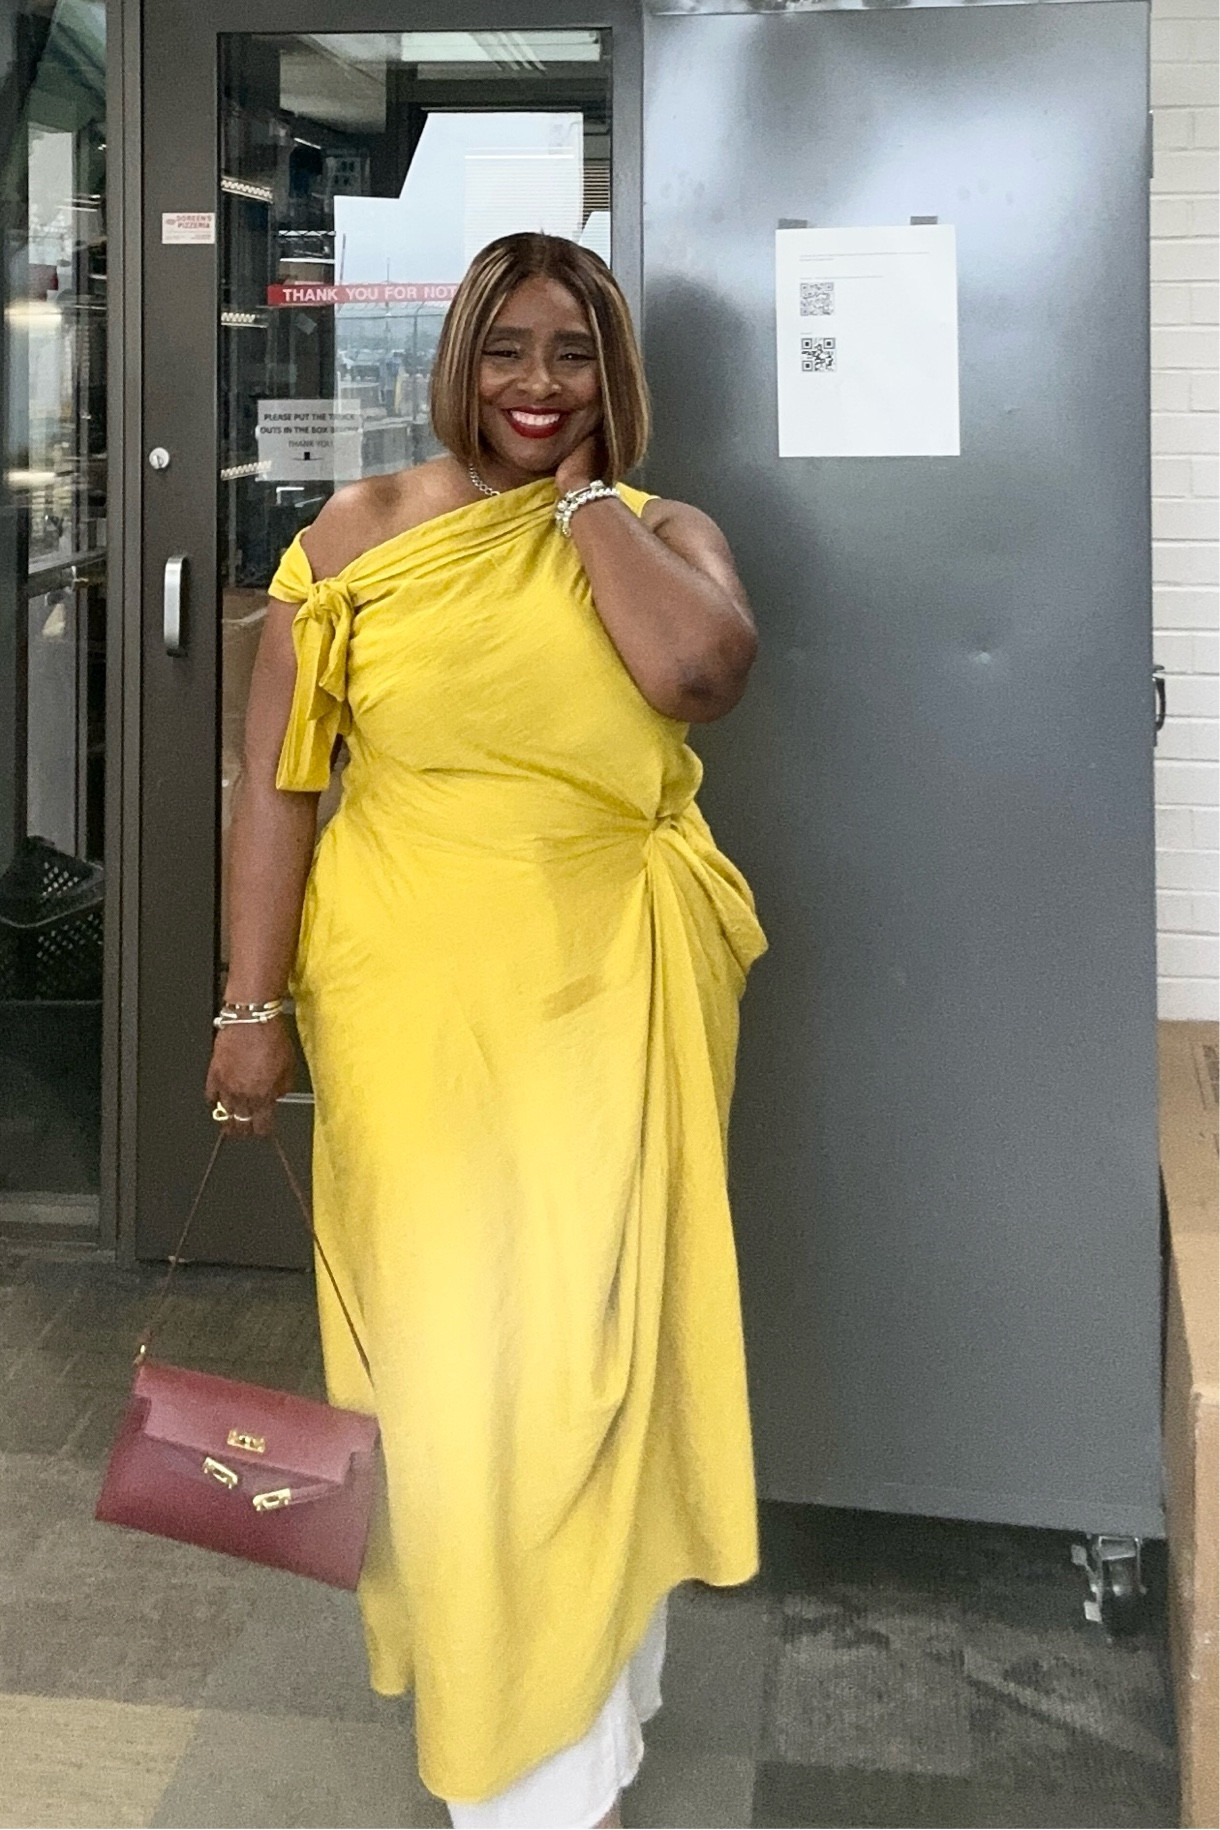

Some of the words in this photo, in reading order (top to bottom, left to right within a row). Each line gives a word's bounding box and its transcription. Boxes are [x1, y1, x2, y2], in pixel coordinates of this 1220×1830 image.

[283, 288, 337, 301] THANK
[345, 287, 378, 300] YOU
[385, 286, 417, 299] FOR
[424, 285, 458, 298] NOT
[263, 413, 292, 421] PLEASE
[294, 413, 310, 421] PUT
[312, 413, 327, 421] THE
[260, 426, 282, 434] OUTS
[283, 426, 292, 434] IN
[294, 426, 309, 434] THE
[311, 426, 328, 434] BOX
[288, 440, 315, 448] THANK
